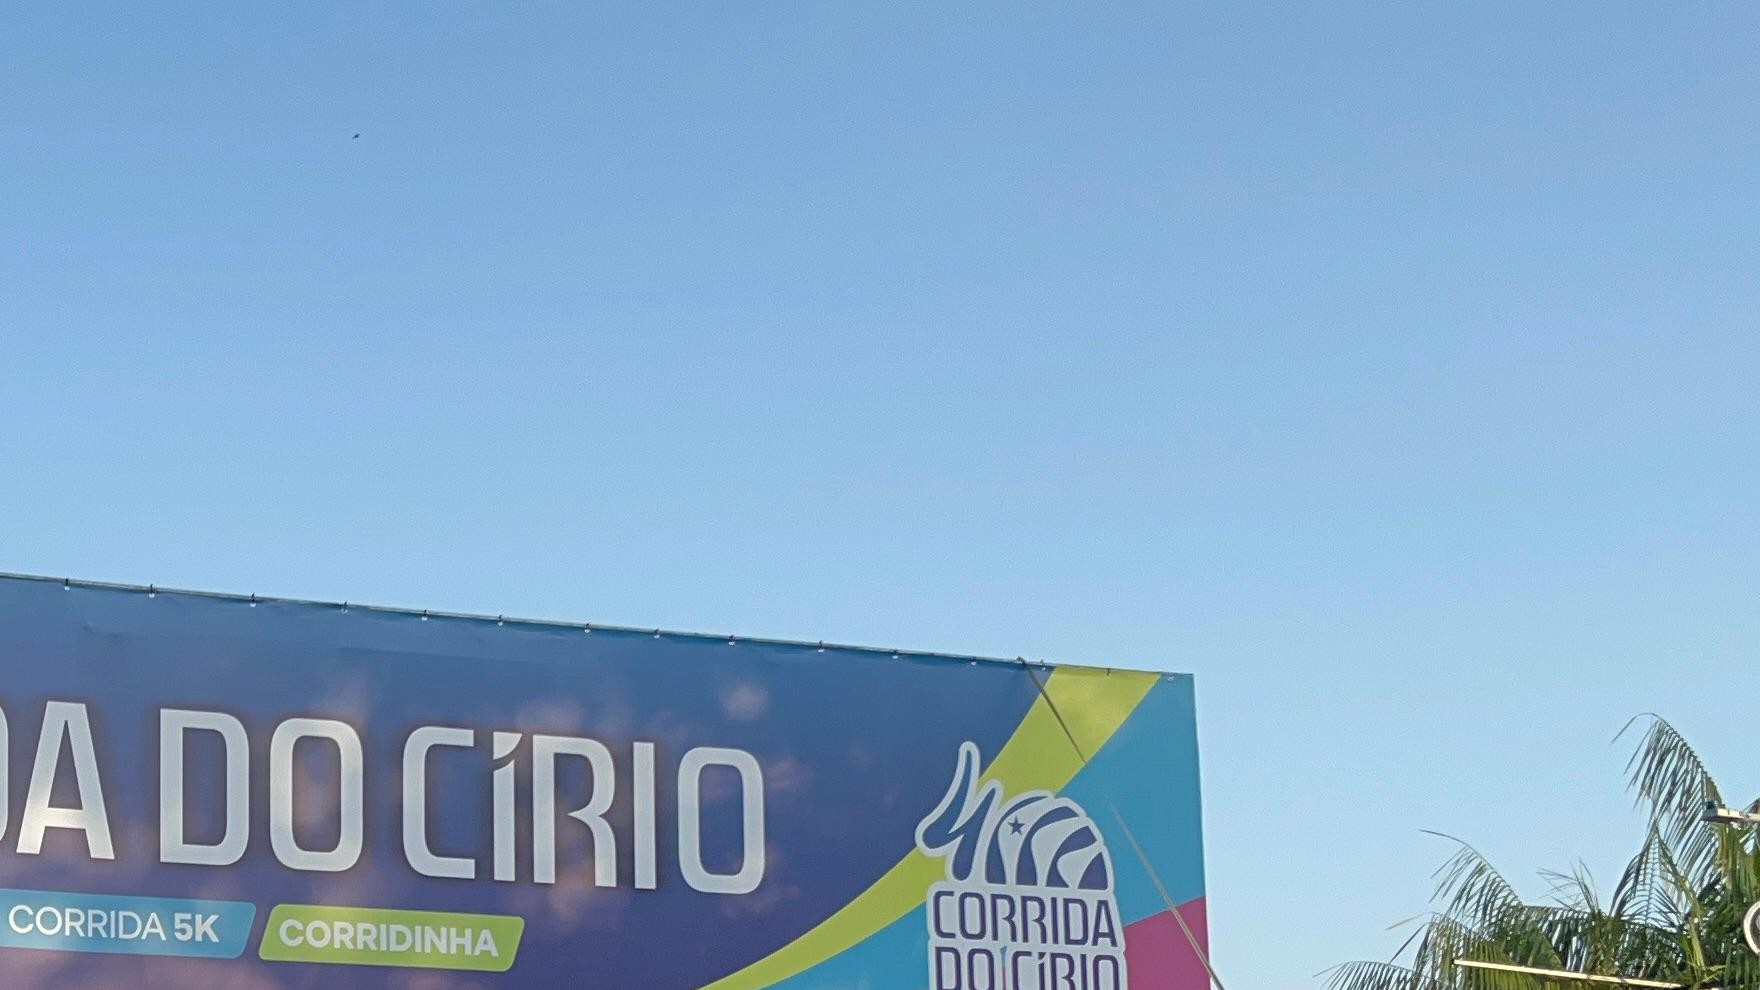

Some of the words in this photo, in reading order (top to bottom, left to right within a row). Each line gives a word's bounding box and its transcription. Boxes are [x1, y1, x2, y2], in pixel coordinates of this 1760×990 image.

[158, 708, 364, 873] DO
[402, 726, 766, 895] CÍRIO
[8, 903, 167, 943] CORRIDA
[173, 912, 220, 944] 5K
[278, 918, 499, 958] CORRIDINHA
[932, 889, 1119, 948] CORRIDA
